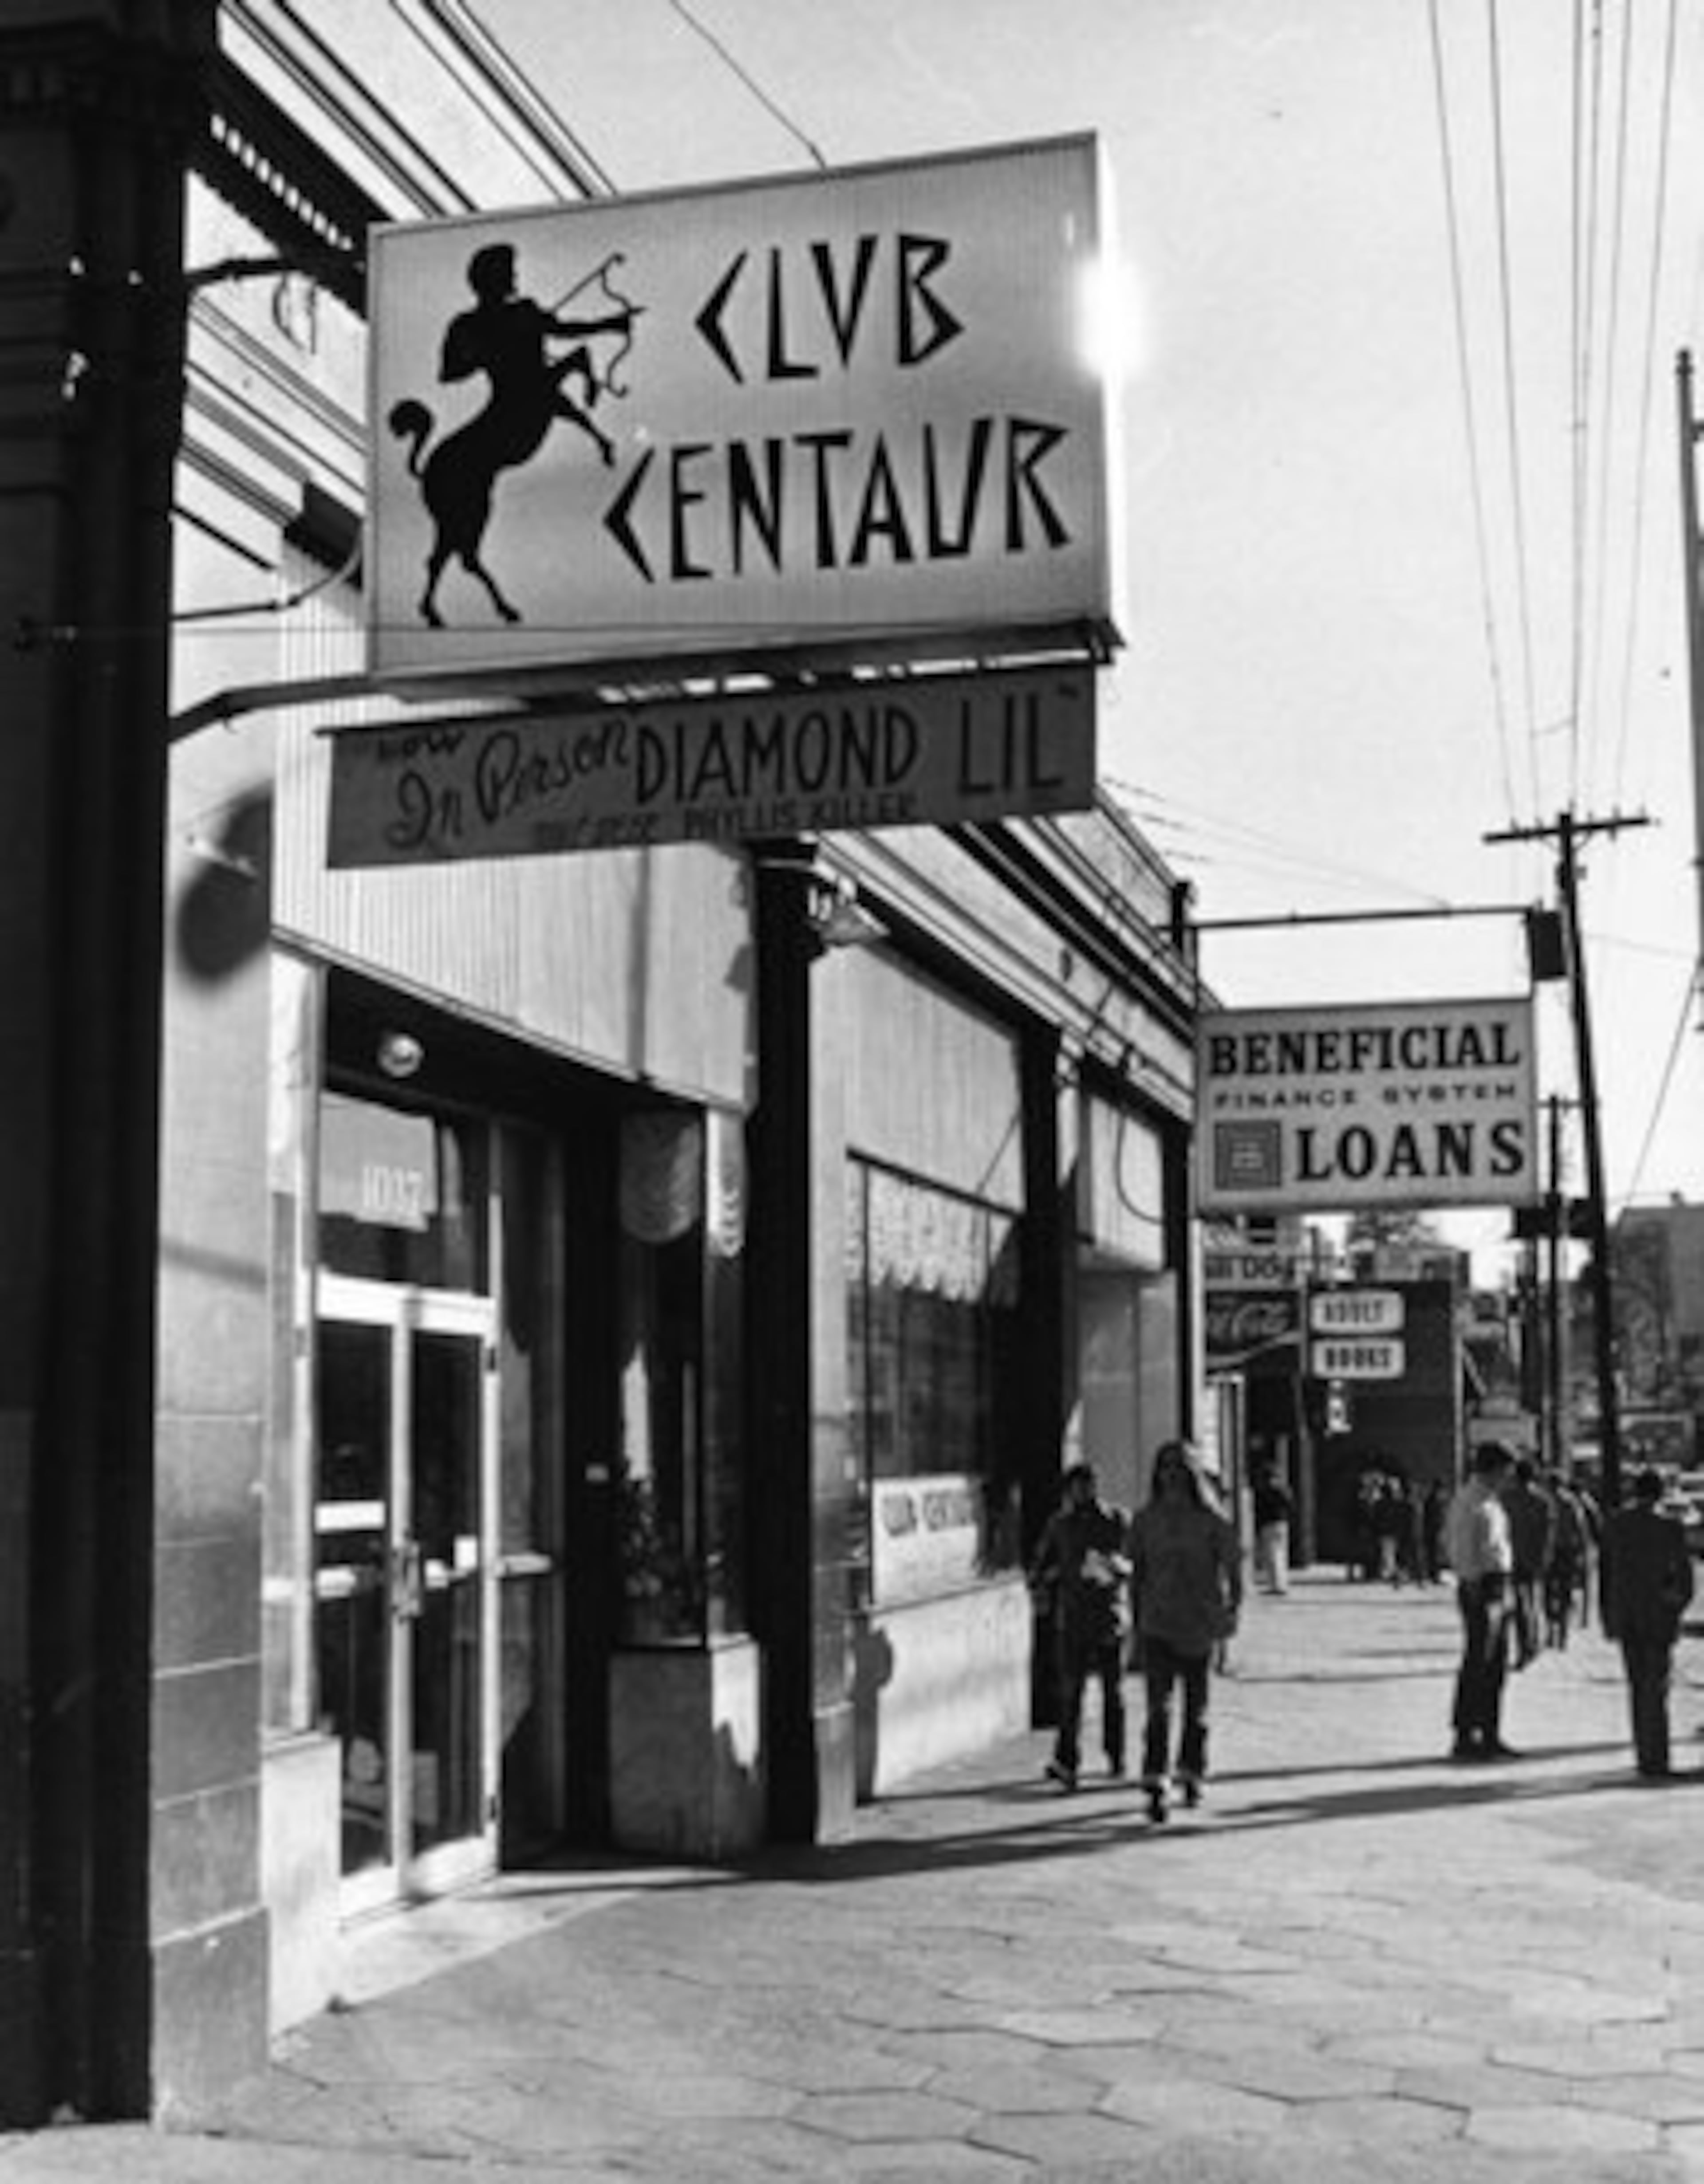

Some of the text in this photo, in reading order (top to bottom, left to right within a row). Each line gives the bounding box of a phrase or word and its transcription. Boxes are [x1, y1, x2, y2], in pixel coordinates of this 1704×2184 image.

[602, 415, 1072, 585] CENTAUR
[637, 710, 919, 804] DIAMOND
[1209, 1023, 1520, 1076] BENEFICIAL
[1215, 1083, 1516, 1109] FINANCE SYSTEM
[1296, 1120, 1524, 1182] LOANS
